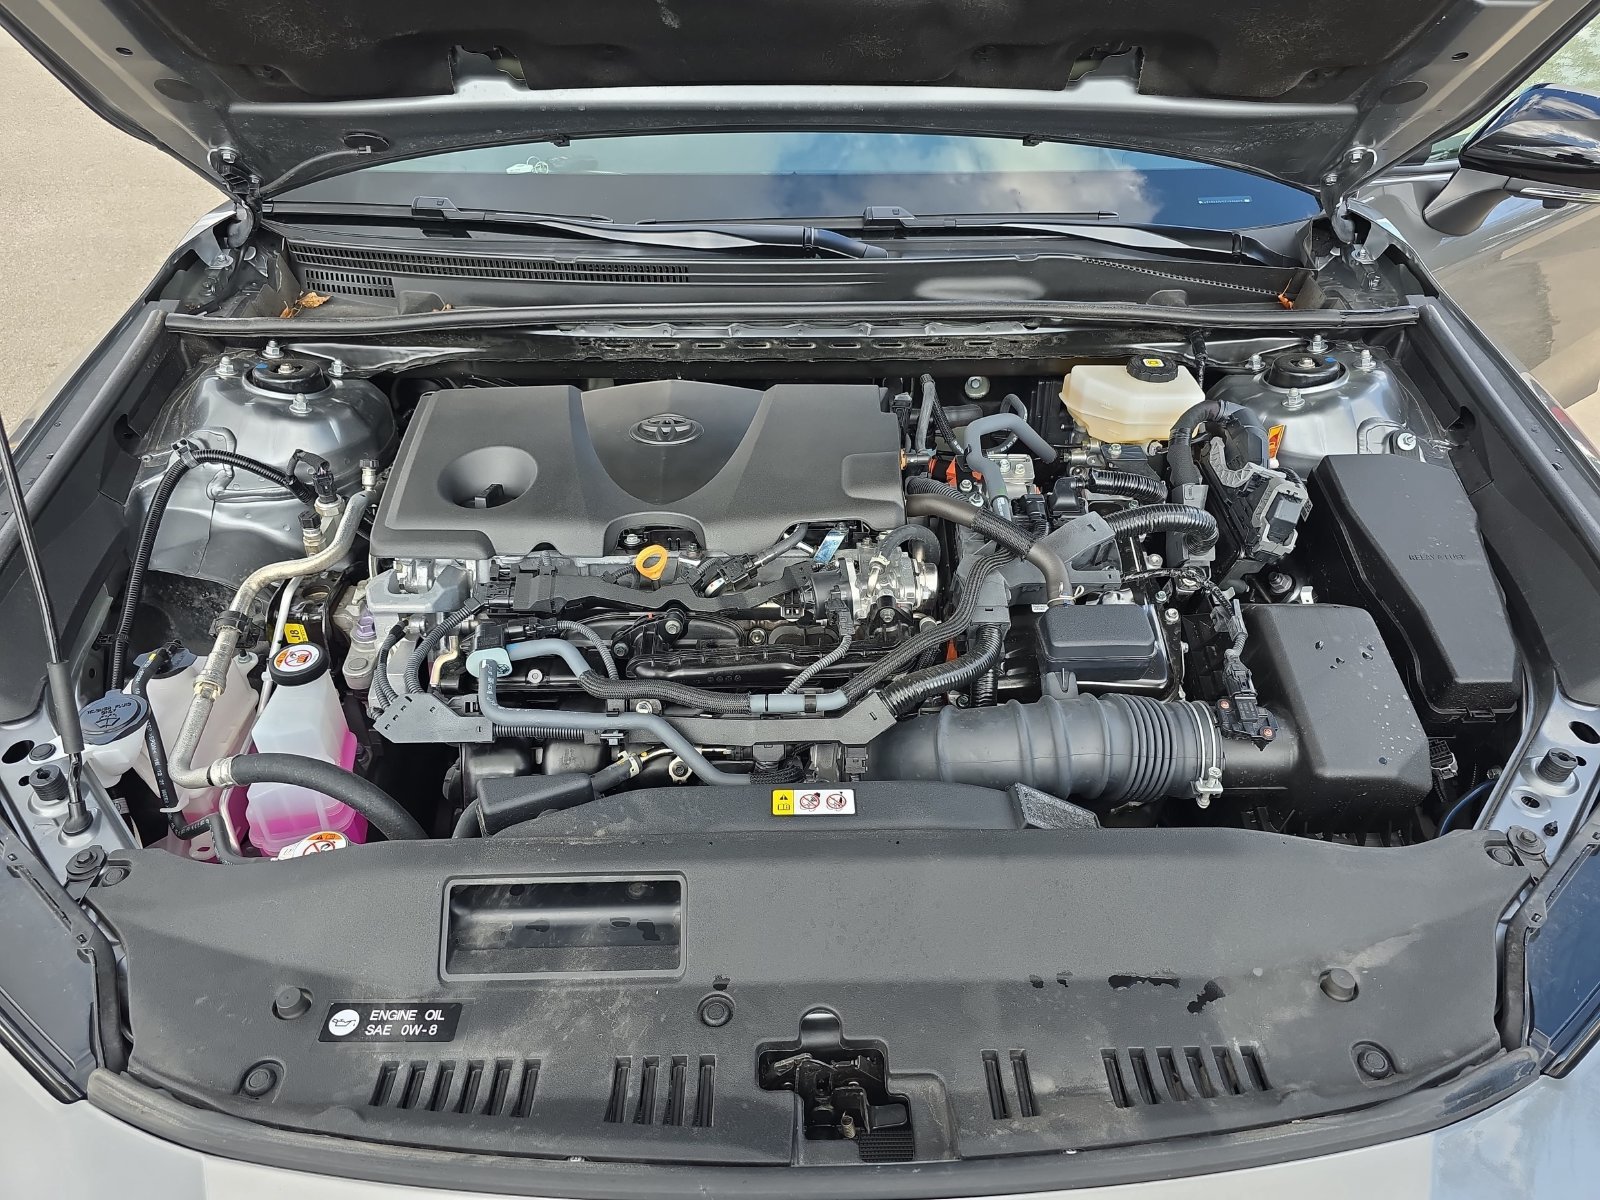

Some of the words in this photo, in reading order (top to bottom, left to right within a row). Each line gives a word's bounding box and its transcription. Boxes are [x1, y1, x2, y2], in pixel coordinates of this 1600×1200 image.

[369, 1009, 418, 1021] ENGINE
[424, 1009, 445, 1021] OIL
[365, 1024, 393, 1036] SAE
[400, 1024, 438, 1036] 0W-8
